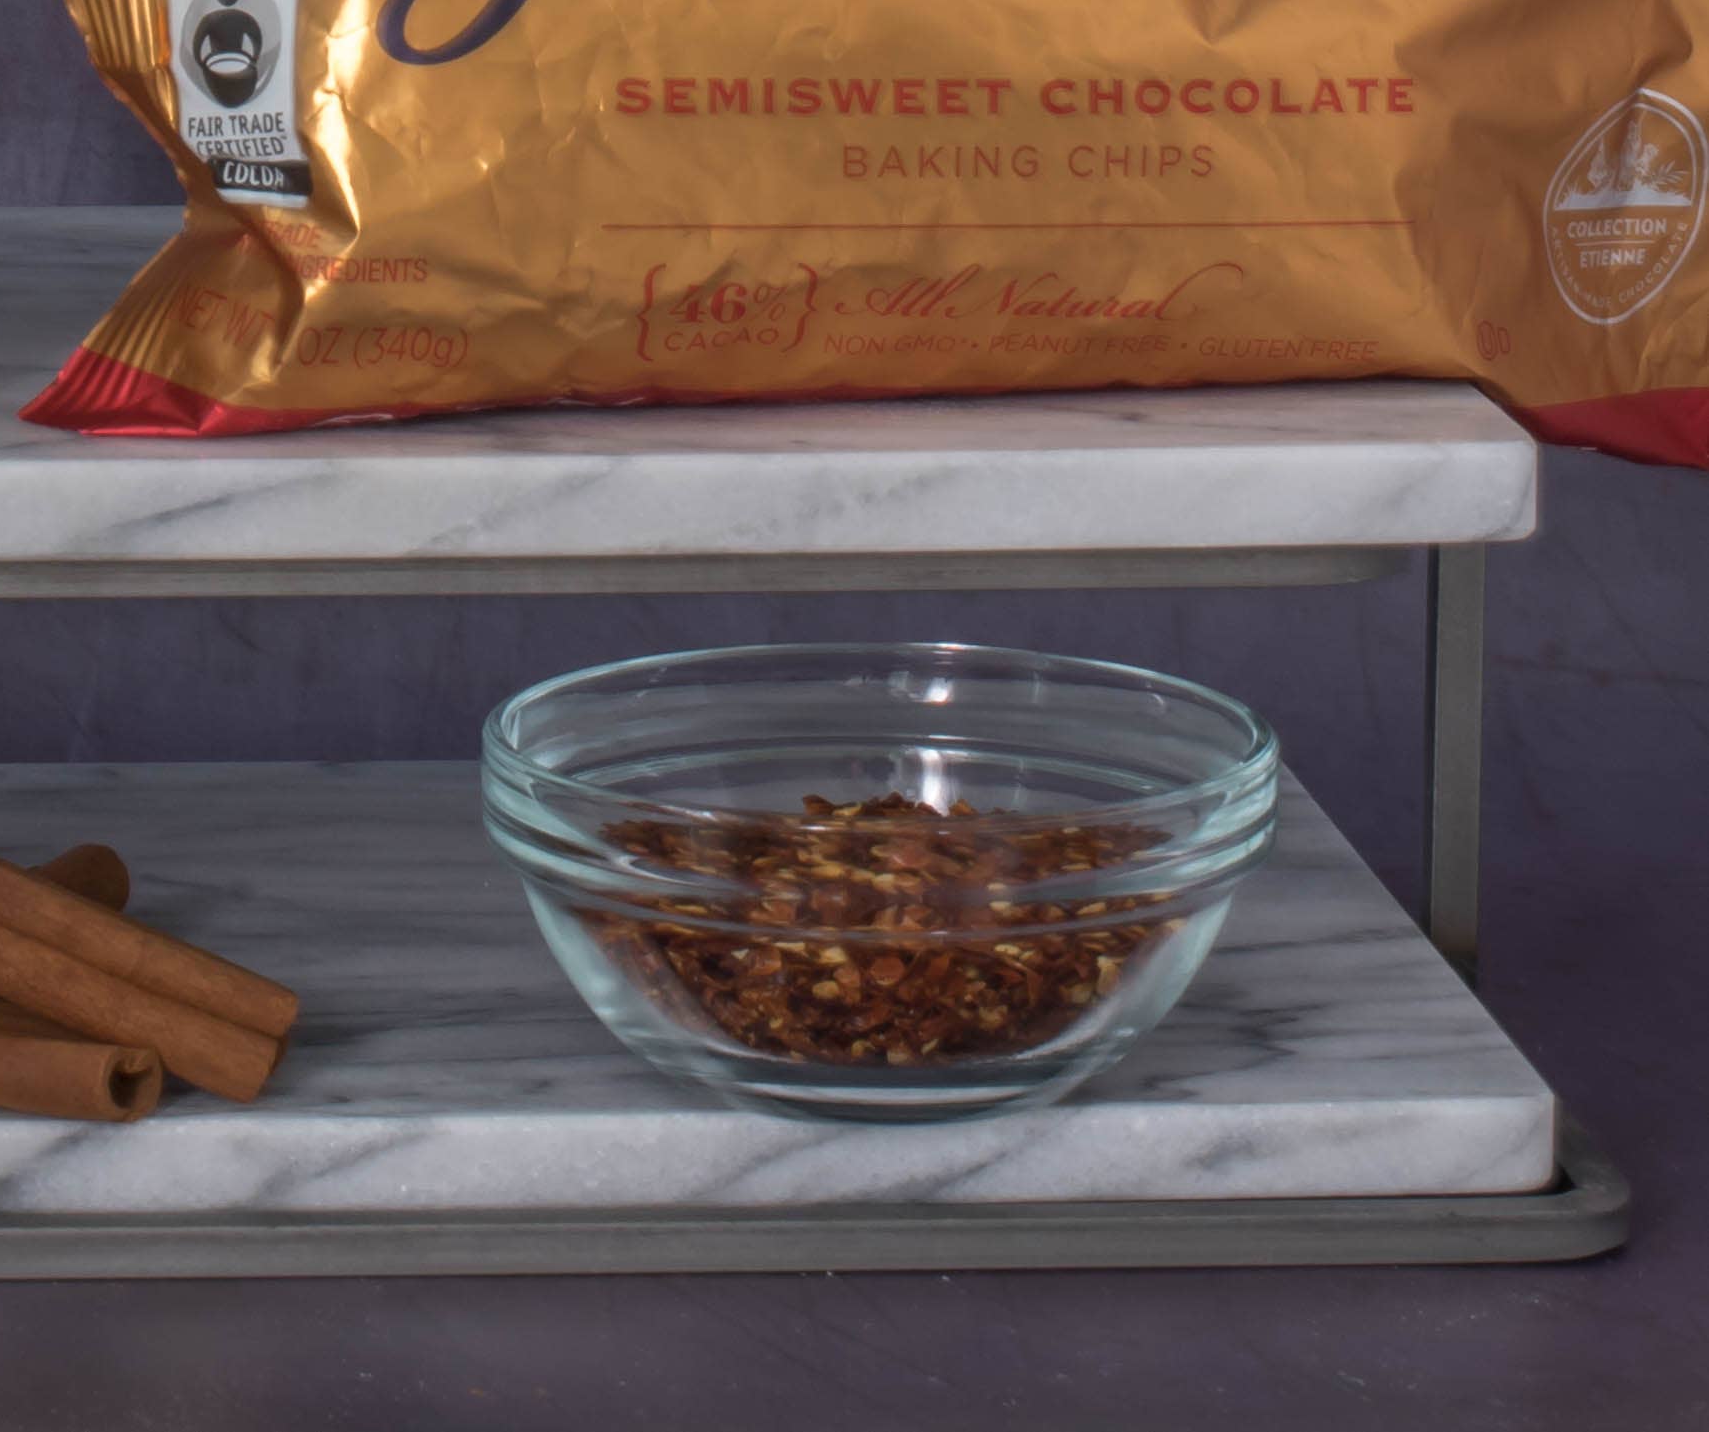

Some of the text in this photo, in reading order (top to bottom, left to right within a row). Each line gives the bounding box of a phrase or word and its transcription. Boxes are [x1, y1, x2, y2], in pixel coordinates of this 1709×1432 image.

[615, 77, 1415, 116] SEMISWEET CHOCOLATE
[188, 112, 285, 137] FAIR TRADE
[844, 145, 1213, 179] BAKING CHIPS
[1566, 218, 1667, 239] COLLECTION
[669, 282, 788, 324] 46%
[664, 328, 779, 352] CACAO
